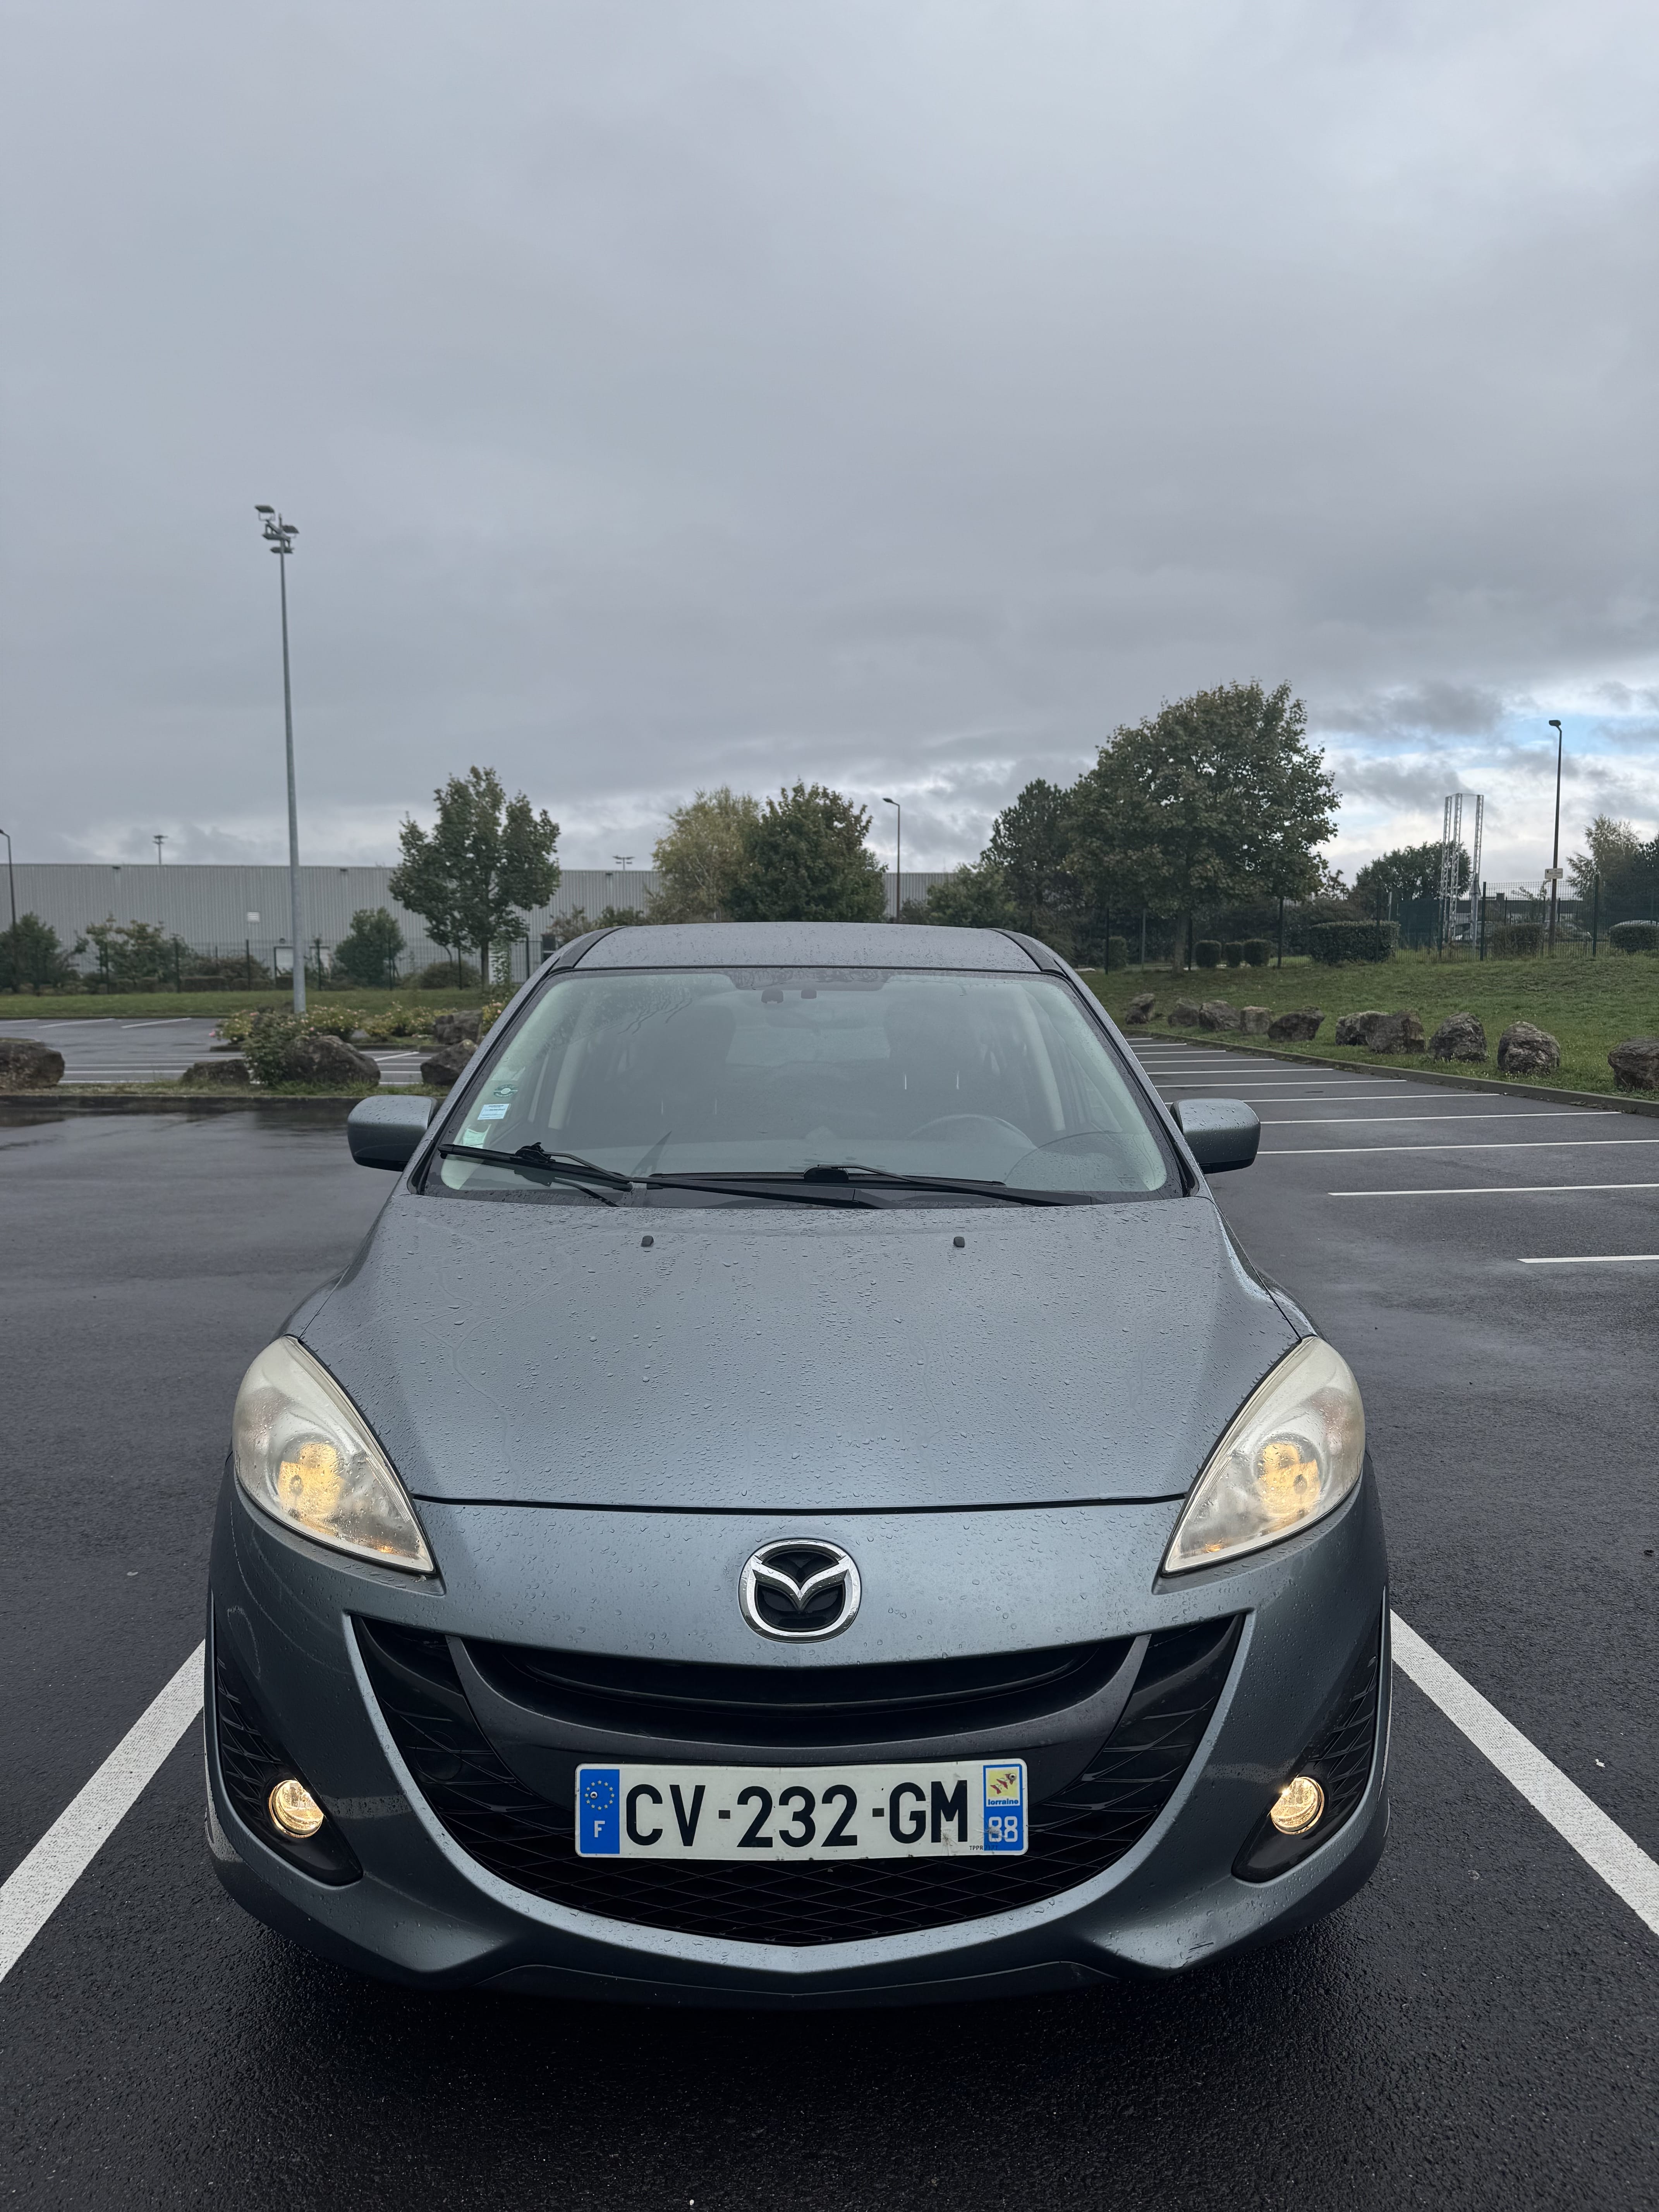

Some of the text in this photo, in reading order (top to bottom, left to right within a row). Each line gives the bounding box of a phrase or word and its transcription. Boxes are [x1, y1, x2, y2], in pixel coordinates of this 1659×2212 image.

[625, 1780, 968, 1848] CV-232-GM
[594, 1820, 605, 1838] F
[988, 1816, 1018, 1842] 88
